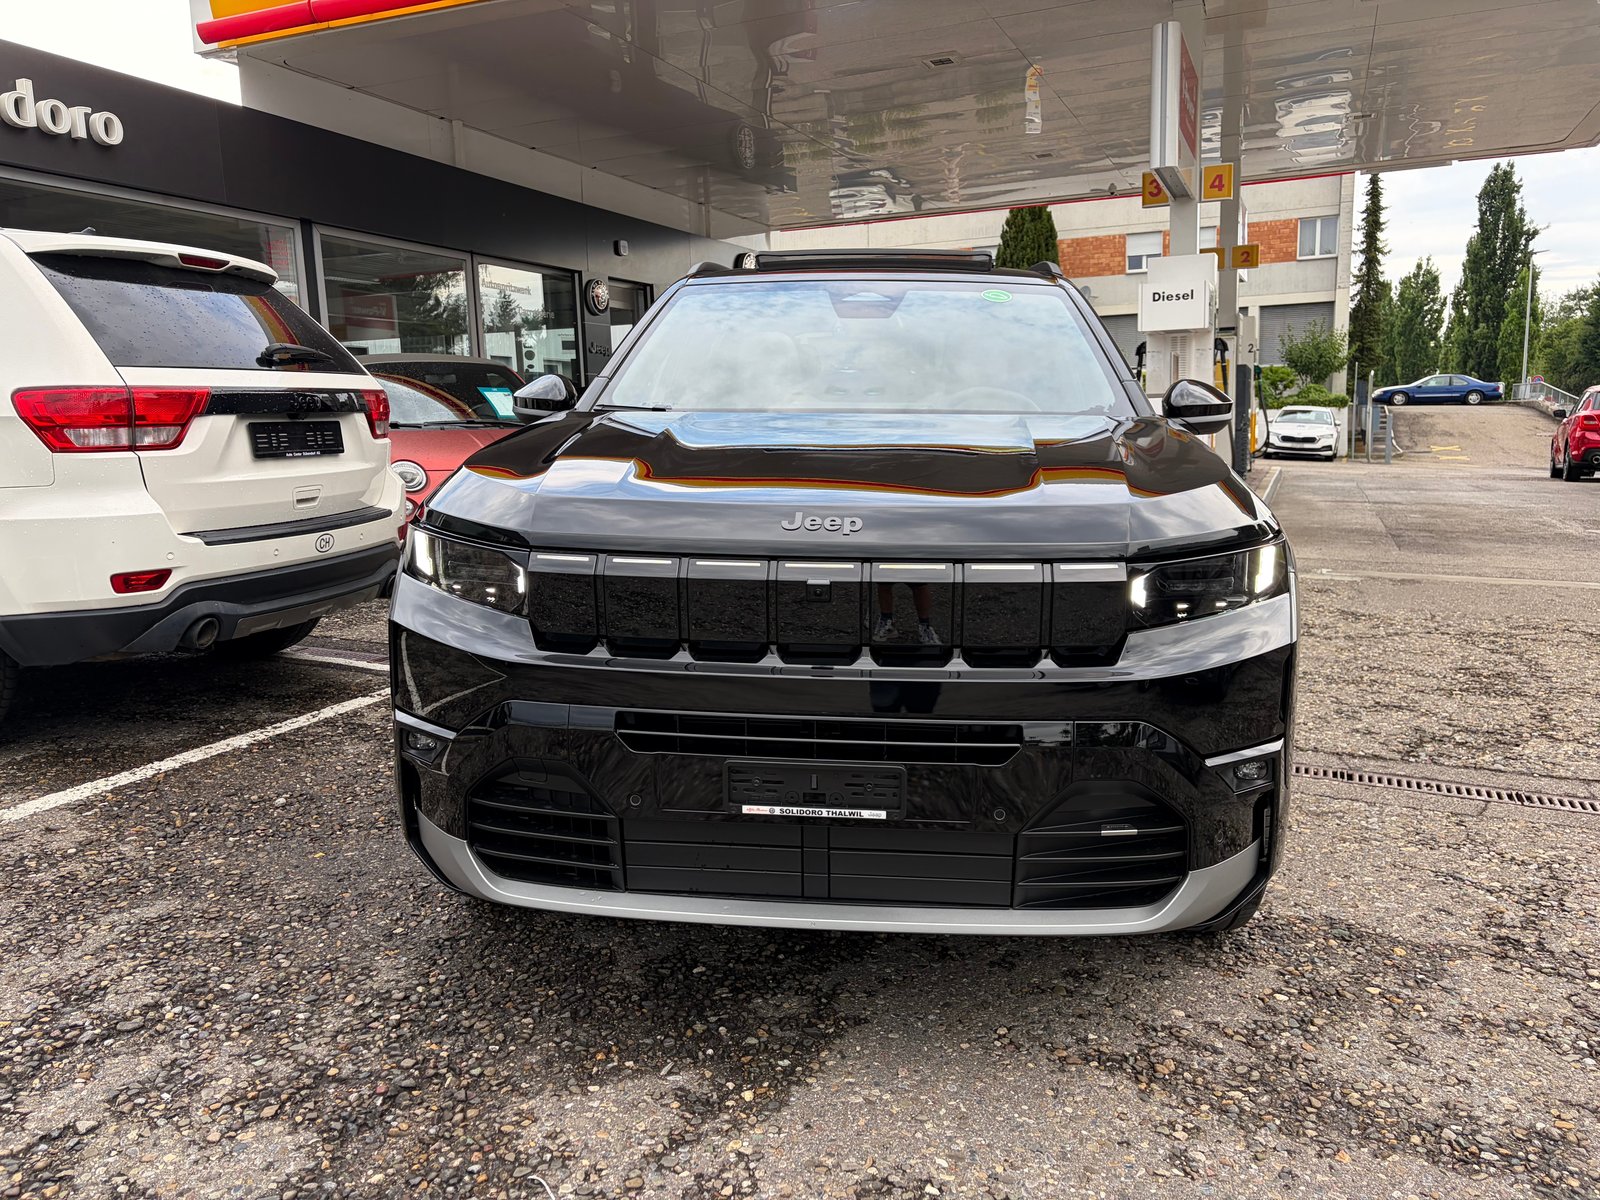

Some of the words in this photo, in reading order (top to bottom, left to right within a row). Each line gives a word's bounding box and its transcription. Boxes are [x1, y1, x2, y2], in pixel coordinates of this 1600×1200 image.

[0, 78, 124, 146] doro
[1148, 179, 1162, 198] 3
[1209, 174, 1225, 192] 4
[1240, 250, 1251, 263] 2
[1152, 289, 1194, 303] Diesel
[588, 341, 611, 357] Jeep
[1248, 344, 1254, 353] 2
[781, 511, 863, 536] Jeep
[320, 537, 330, 549] CH
[779, 808, 823, 816] SOLIDORO
[827, 809, 864, 818] THALWIL
